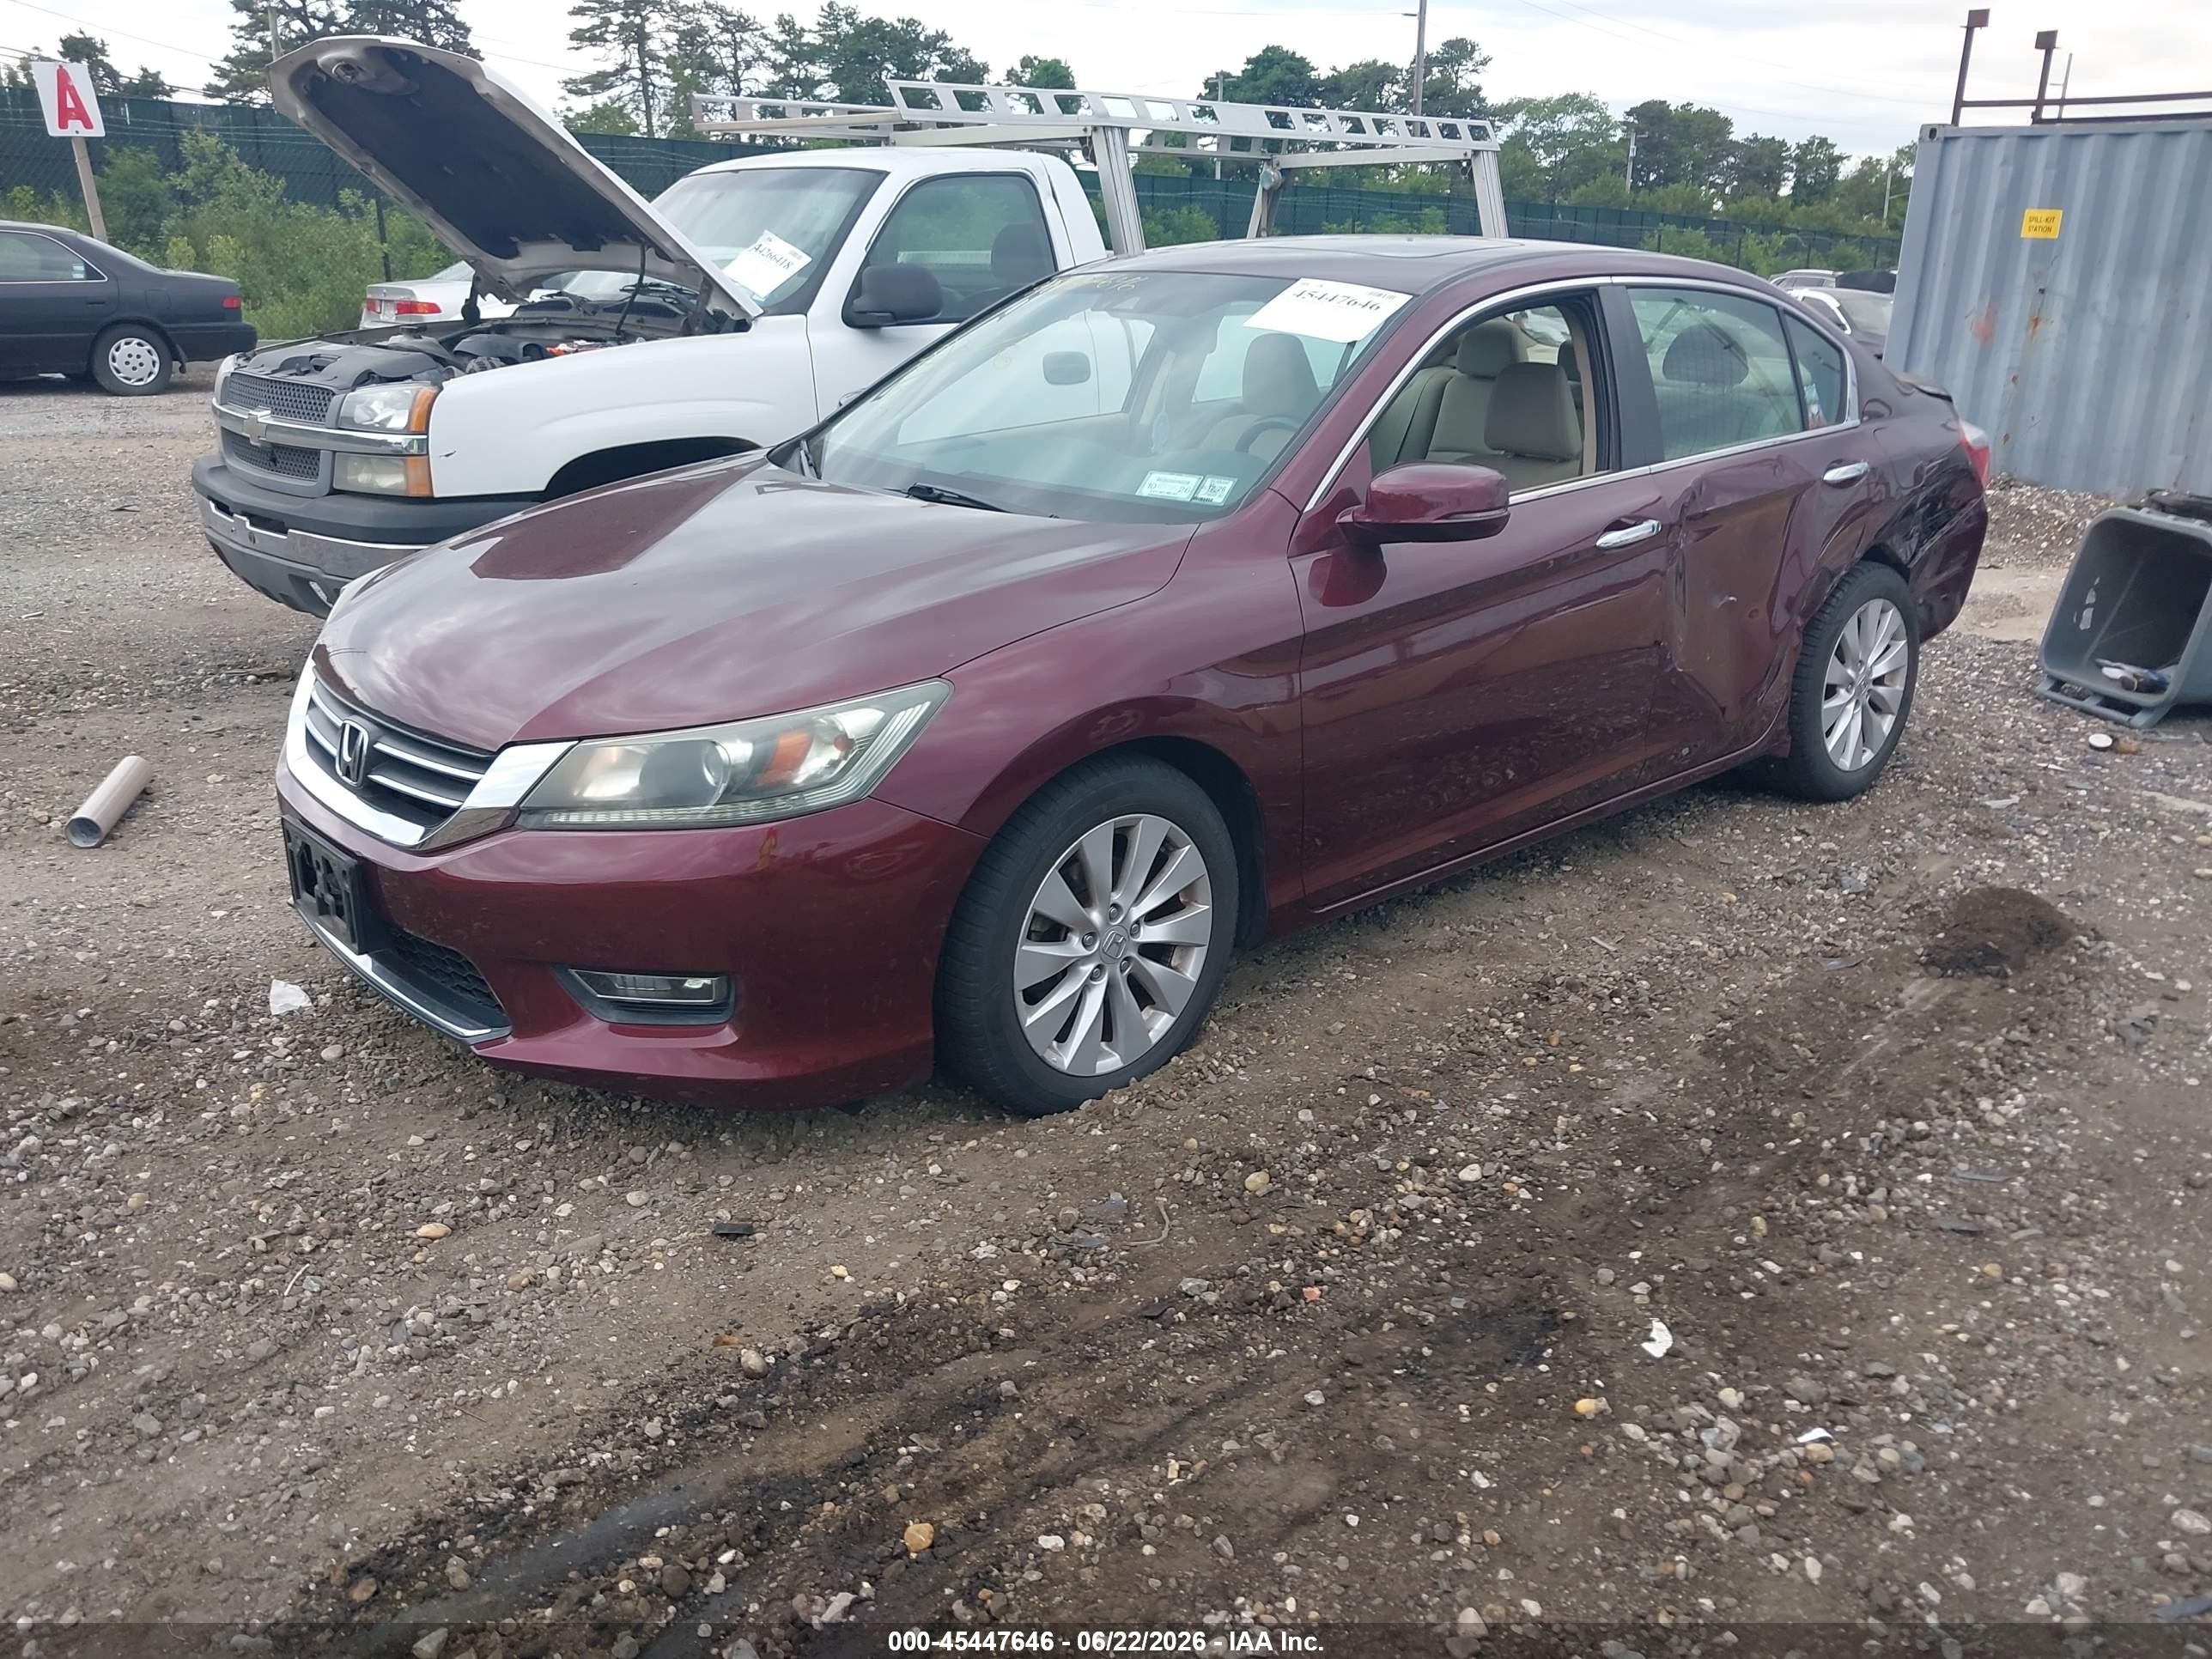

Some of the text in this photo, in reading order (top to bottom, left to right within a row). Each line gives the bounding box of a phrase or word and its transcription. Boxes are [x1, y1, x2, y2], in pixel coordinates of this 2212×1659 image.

[57, 68, 94, 130] A
[2028, 225, 2053, 234] STATION
[1293, 289, 1382, 311] 45447646
